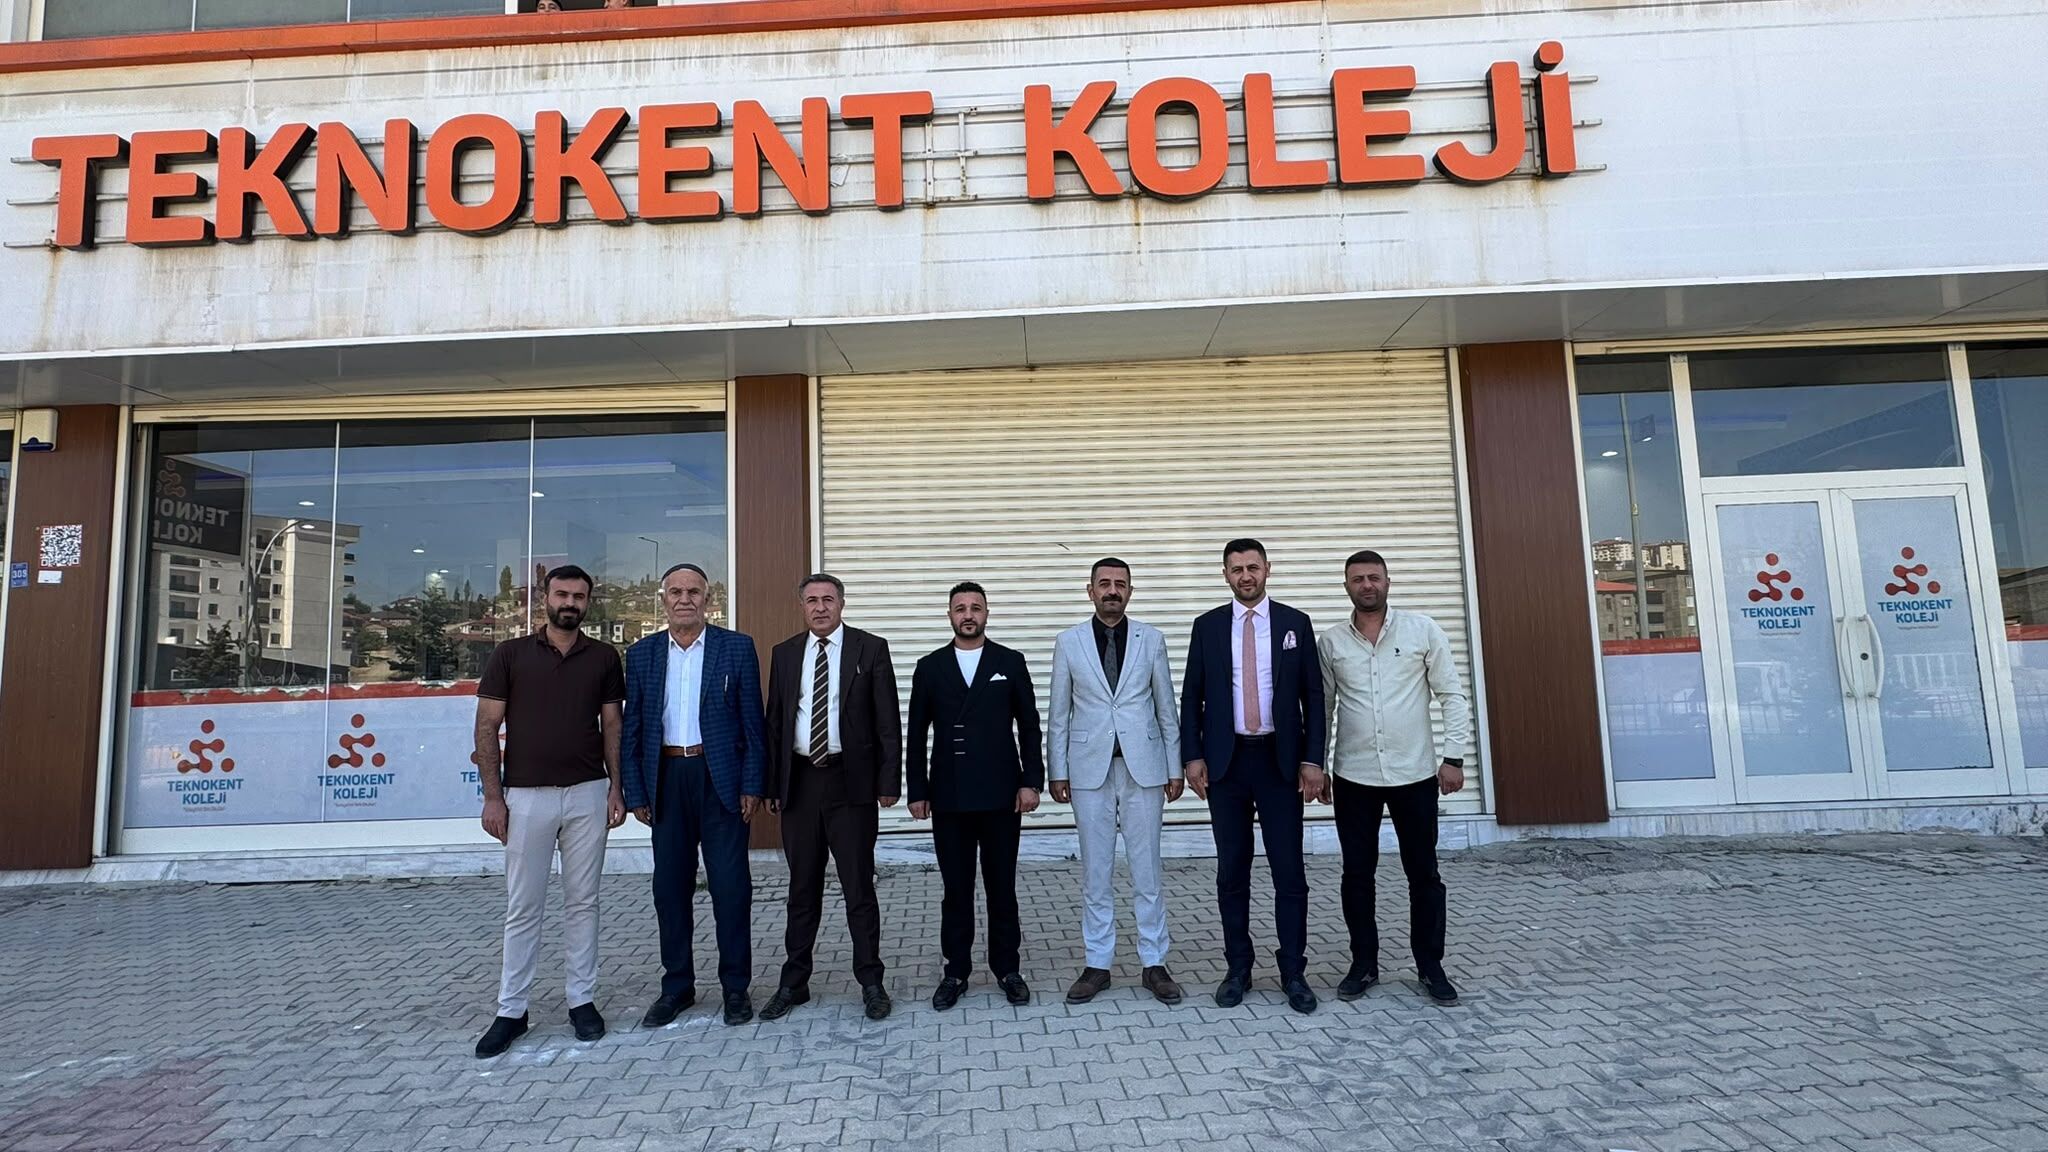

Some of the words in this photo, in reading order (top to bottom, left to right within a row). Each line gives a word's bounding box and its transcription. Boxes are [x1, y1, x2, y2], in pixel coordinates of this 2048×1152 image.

[32, 91, 935, 248] TEKNOKENT
[1741, 605, 1816, 618] TEKNOKENT
[1877, 599, 1953, 612] TEKNOKENT
[167, 778, 244, 792] TEKNOKENT
[317, 773, 395, 787] TEKNOKENT
